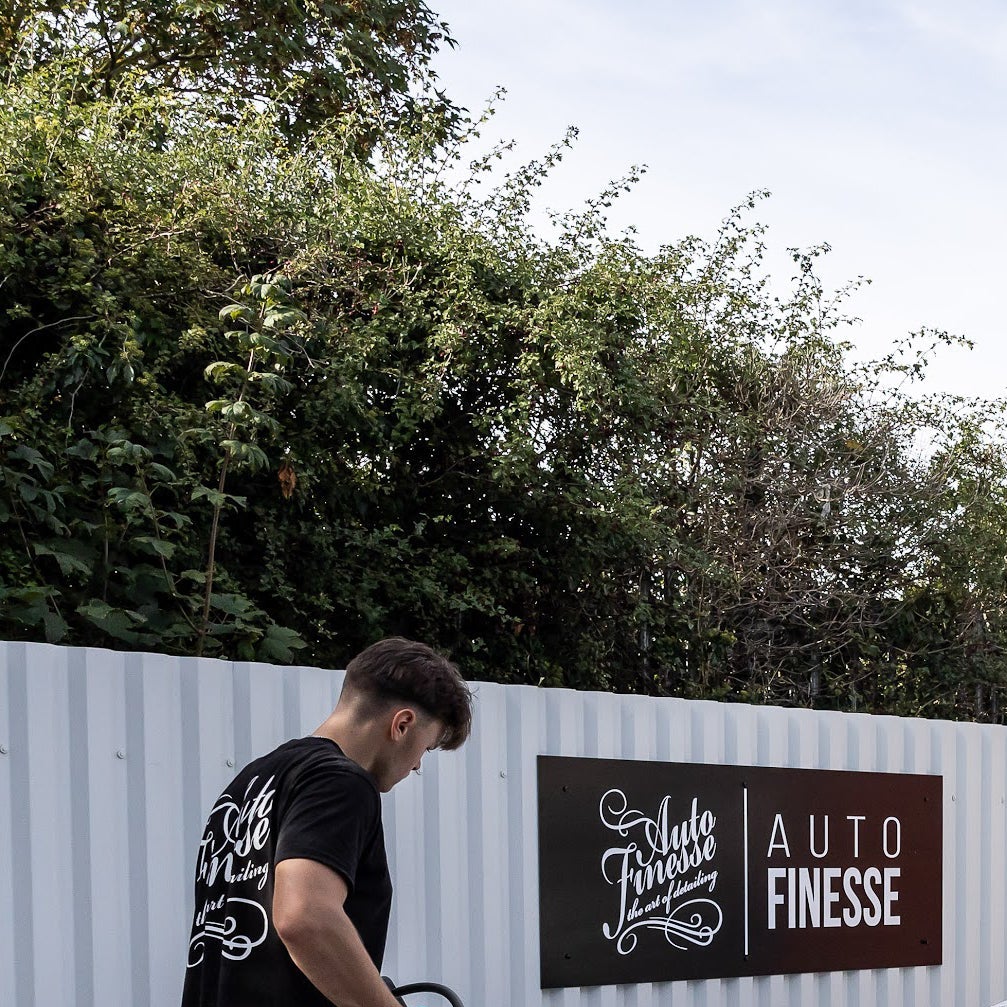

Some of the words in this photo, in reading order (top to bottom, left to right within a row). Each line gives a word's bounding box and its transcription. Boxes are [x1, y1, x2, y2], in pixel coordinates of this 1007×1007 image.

[600, 789, 716, 867] Auto
[767, 813, 901, 859] AUTO
[602, 843, 716, 940] Finesse
[626, 898, 644, 922] the
[645, 894, 661, 914] art
[662, 880, 675, 914] of
[673, 870, 719, 893] detailing
[767, 867, 901, 929] FINESSE
